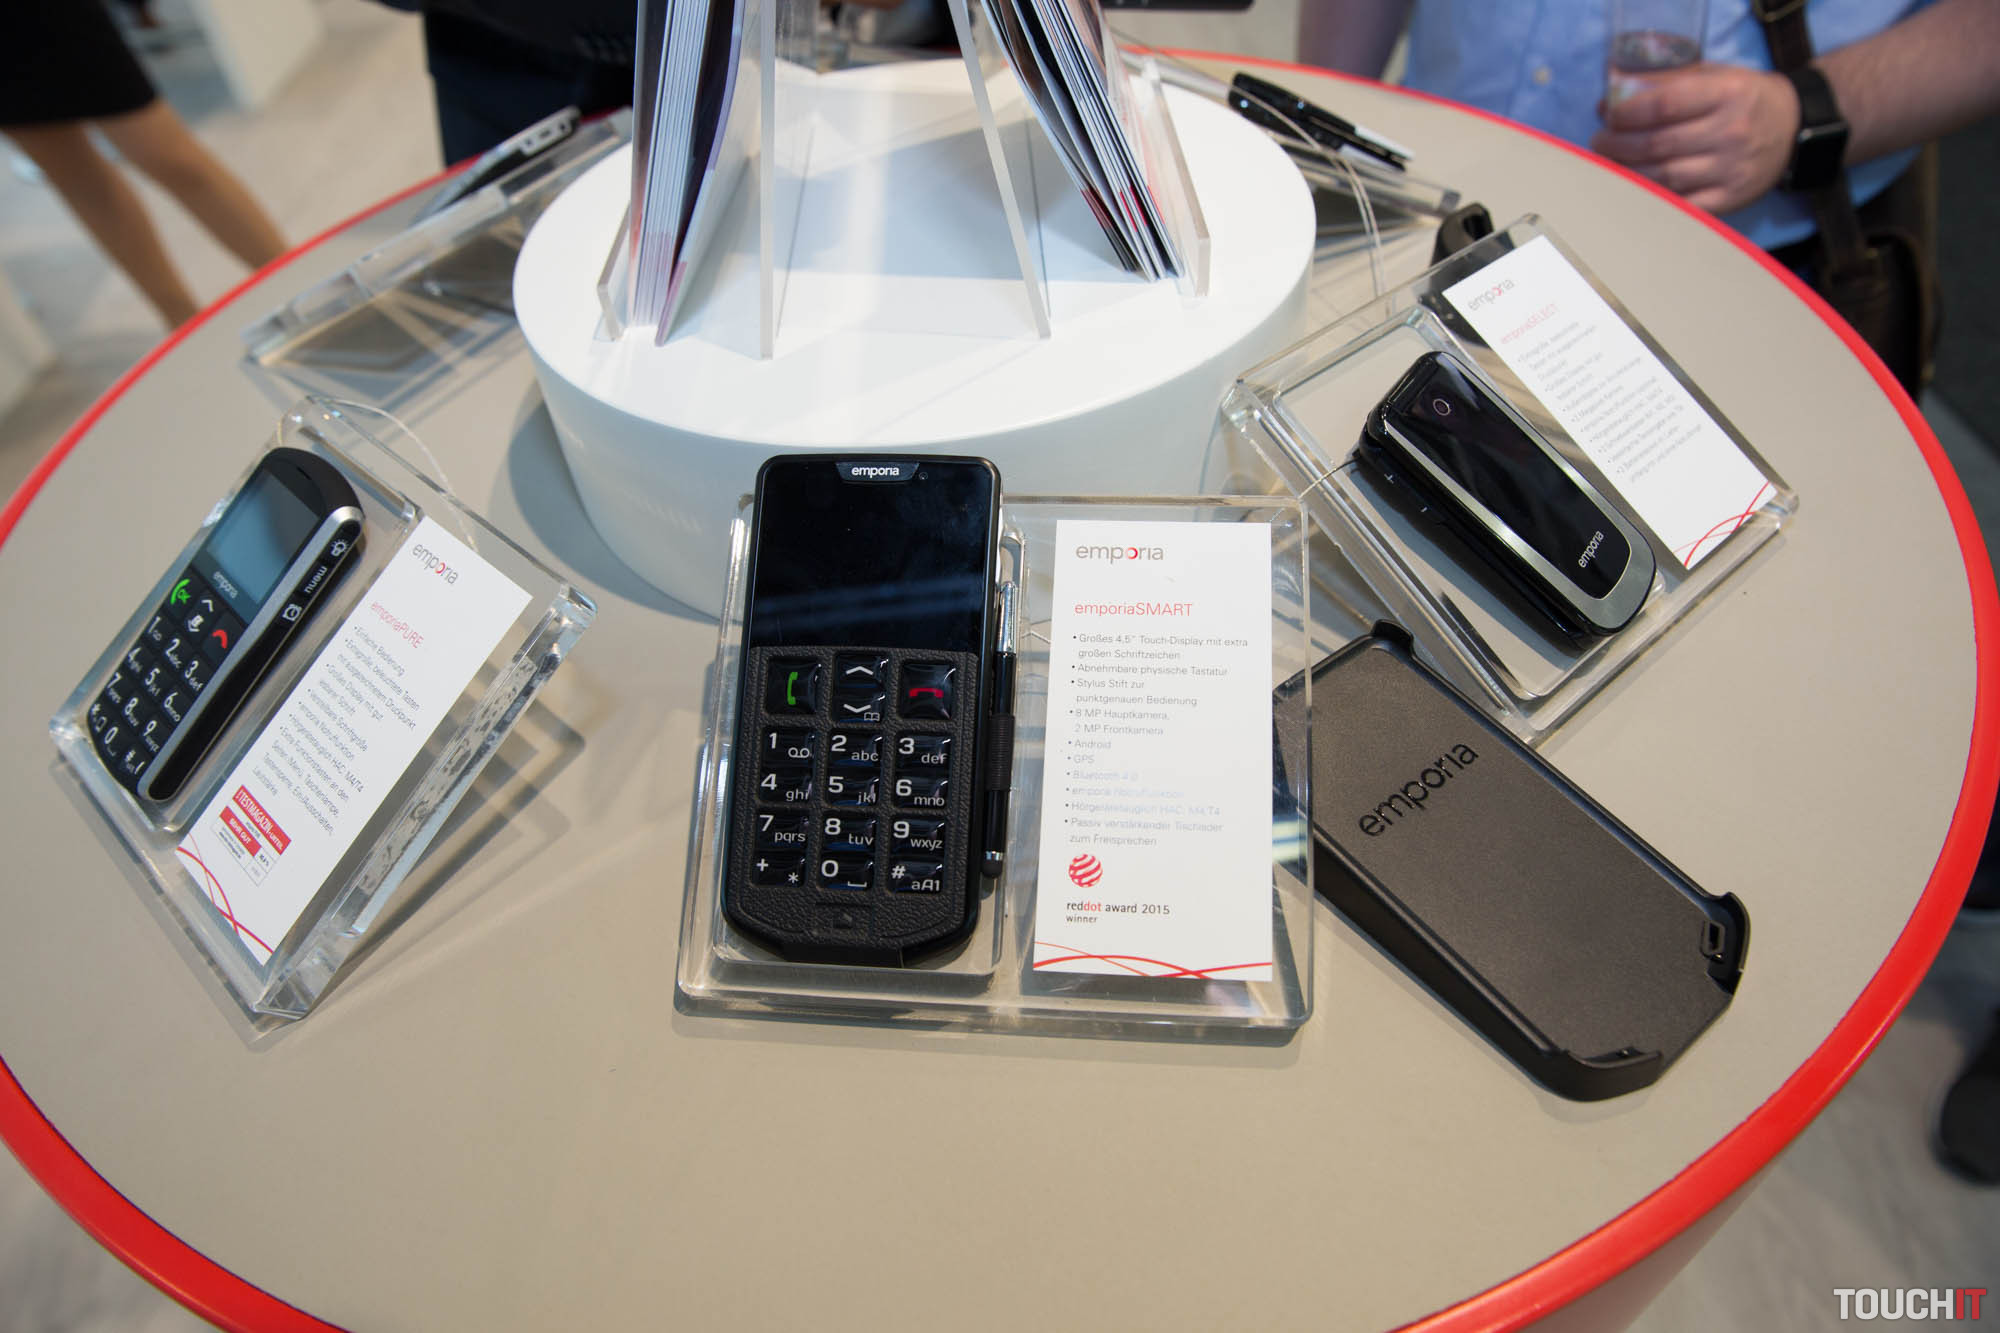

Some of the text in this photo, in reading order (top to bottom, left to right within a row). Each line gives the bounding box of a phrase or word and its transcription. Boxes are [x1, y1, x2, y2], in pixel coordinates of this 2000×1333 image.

[1467, 279, 1515, 311] emporia
[851, 466, 900, 478] emporia
[1075, 545, 1163, 563] emporia
[1577, 530, 1604, 568] emporia
[412, 544, 459, 584] emporia
[304, 566, 328, 594] menu
[1074, 600, 1192, 617] emporiaSMART
[165, 638, 180, 657] 2
[1079, 634, 1112, 642] Großes
[1140, 635, 1203, 646] Touch-Display
[1206, 637, 1221, 645] mit
[1078, 649, 1180, 659] großen Schriftzeichen
[145, 668, 160, 685] 5
[185, 661, 198, 679] 3
[1077, 663, 1227, 676] Abnehmbare physische Tastatur
[108, 672, 122, 688] 7
[1077, 678, 1105, 688] Stylus
[1108, 679, 1127, 687] Stift
[125, 698, 138, 715] 8
[164, 692, 178, 709] 6
[1076, 693, 1197, 707] punktgenauen Bedienung
[1075, 708, 1081, 717] 8
[1084, 708, 1101, 717] MP
[105, 726, 118, 744] 0
[143, 720, 156, 736] 9
[1074, 723, 1163, 734] 2 MP Frontkamera
[768, 733, 778, 749] 1
[831, 735, 879, 762] 2 abc
[1074, 739, 1111, 749] Android
[899, 738, 948, 764] 3 def
[1073, 754, 1094, 764] GPS
[761, 773, 809, 802] 4 ghi
[828, 776, 877, 805] 5 jkl
[896, 779, 945, 806] 6 mno
[1359, 743, 1479, 836] emporia
[759, 815, 806, 843] 7 pqrs
[825, 818, 874, 845] 8 tuv
[893, 821, 943, 850] 9 wxyz
[1069, 834, 1156, 847] zum Freisprechen
[821, 860, 839, 877] 0
[892, 865, 906, 879] #
[1105, 902, 1137, 913] award
[1141, 904, 1170, 915] 2015
[1066, 914, 1098, 923] winner
